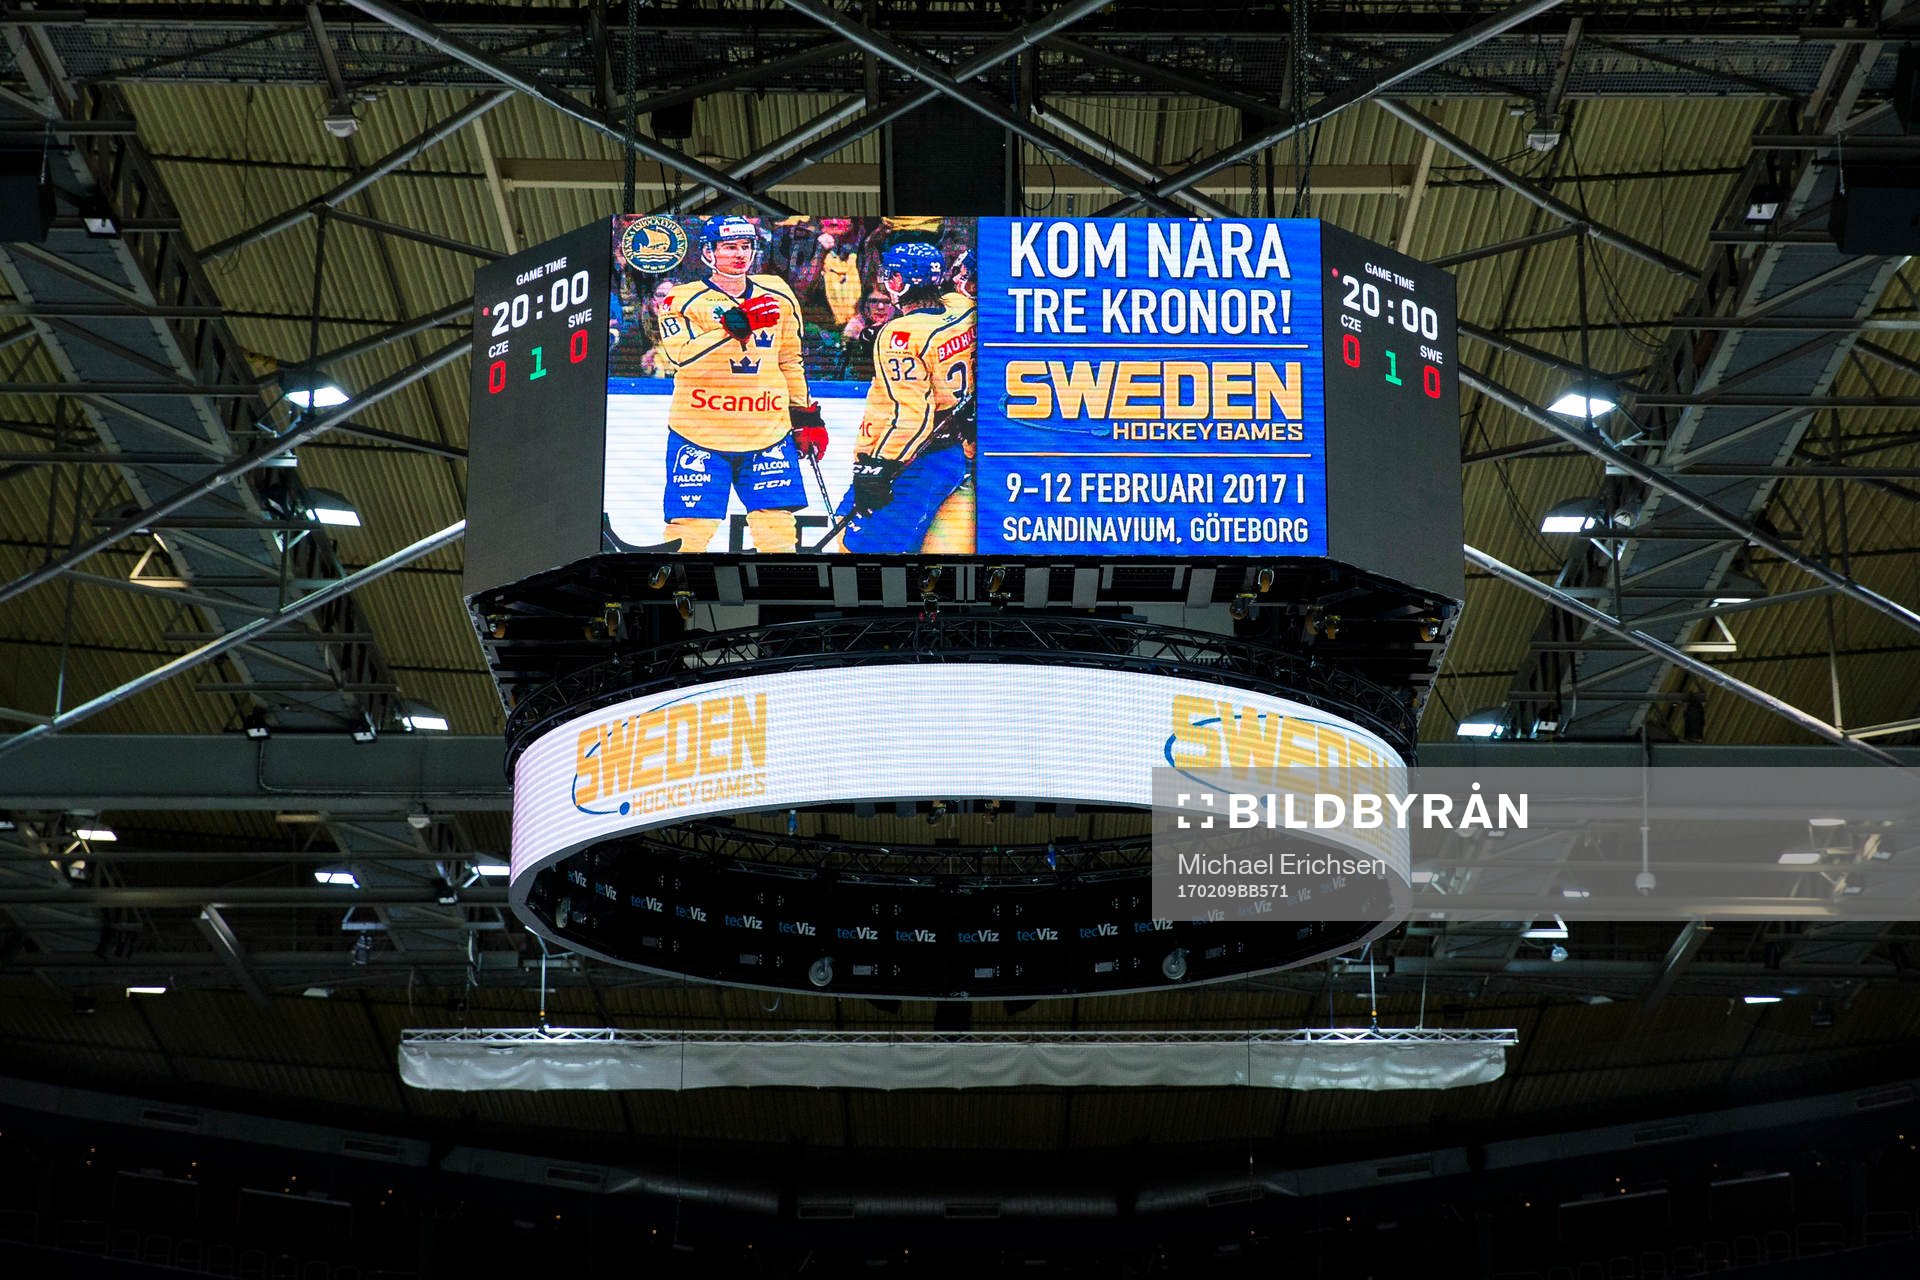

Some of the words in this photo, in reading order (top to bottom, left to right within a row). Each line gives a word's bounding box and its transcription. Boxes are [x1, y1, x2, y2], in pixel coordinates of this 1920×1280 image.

[1010, 221, 1126, 278] KOM
[1147, 217, 1292, 279] NÄRA
[516, 265, 543, 286] GAME
[545, 256, 567, 275] TIME
[1364, 261, 1392, 282] GAME
[1393, 272, 1415, 292] TIME
[491, 269, 589, 337] 20:00
[1007, 288, 1087, 334] TRE
[1102, 288, 1292, 335] KRONOR!
[1342, 274, 1438, 341] 20:00
[568, 308, 592, 329] SWE
[660, 316, 681, 339] 18
[1340, 313, 1362, 333] CZE
[488, 340, 509, 359] CZE
[570, 328, 588, 364] 0
[1343, 333, 1361, 369] 0
[1420, 345, 1443, 365] SWE
[529, 346, 547, 381] 1
[889, 356, 917, 382] 32
[1385, 349, 1402, 386] 1
[488, 359, 507, 395] 0
[1423, 365, 1440, 399] 0
[691, 388, 783, 412] Scandic
[1005, 360, 1302, 420] SWEDEN
[672, 473, 711, 483] FALCON
[752, 461, 790, 472] FALCON
[752, 479, 791, 491] CCM
[1081, 473, 1213, 503] FEBRUARI
[1222, 473, 1287, 504] 2017
[1002, 516, 1183, 545] SCANDINAVIUM,
[1190, 512, 1309, 544] GÖTEBORG
[574, 692, 767, 807] SWEDEN
[631, 894, 663, 912] tecViz
[675, 904, 707, 922] tecViz
[724, 914, 763, 930] tecViz
[779, 921, 816, 937] tecViz
[837, 926, 878, 941] tecViz
[1080, 922, 1119, 938] tecViz
[1134, 917, 1174, 933] tecViz
[896, 928, 936, 943] tecViz
[957, 929, 999, 943] tecViz
[1017, 927, 1059, 942] tecViz
